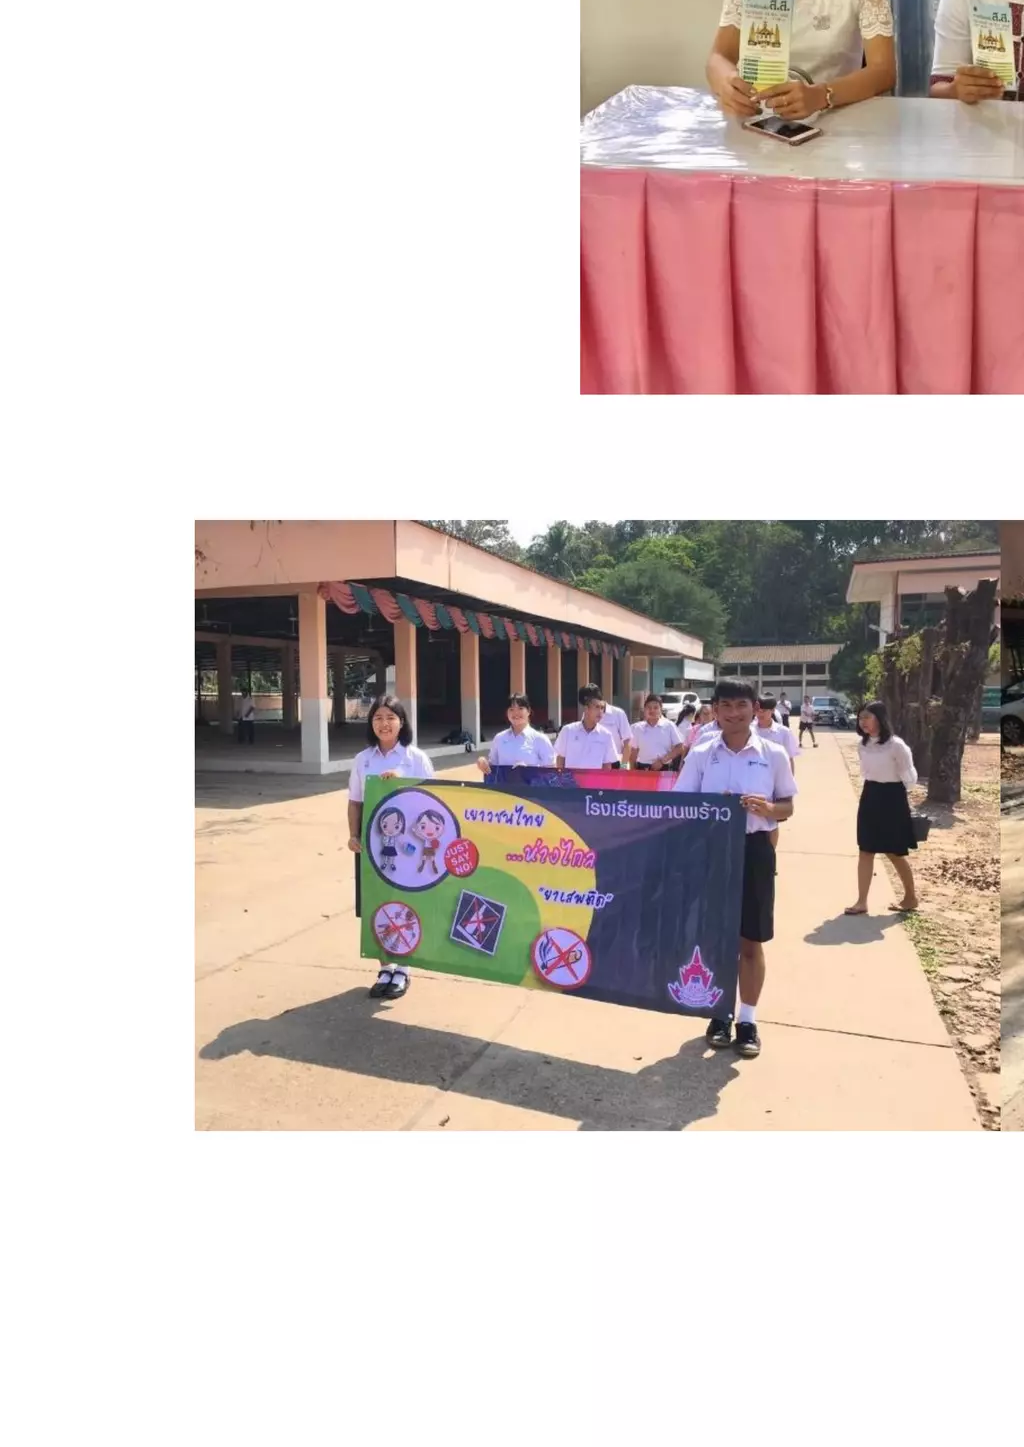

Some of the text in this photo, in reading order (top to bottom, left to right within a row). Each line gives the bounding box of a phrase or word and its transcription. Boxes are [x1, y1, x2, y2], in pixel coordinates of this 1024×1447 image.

[464, 805, 545, 828] เยาวชนไทย
[585, 795, 732, 822] โรงเรียนพานพร้าว
[445, 840, 470, 858] JUST
[450, 851, 470, 866] SAY
[455, 861, 474, 876] NO!
